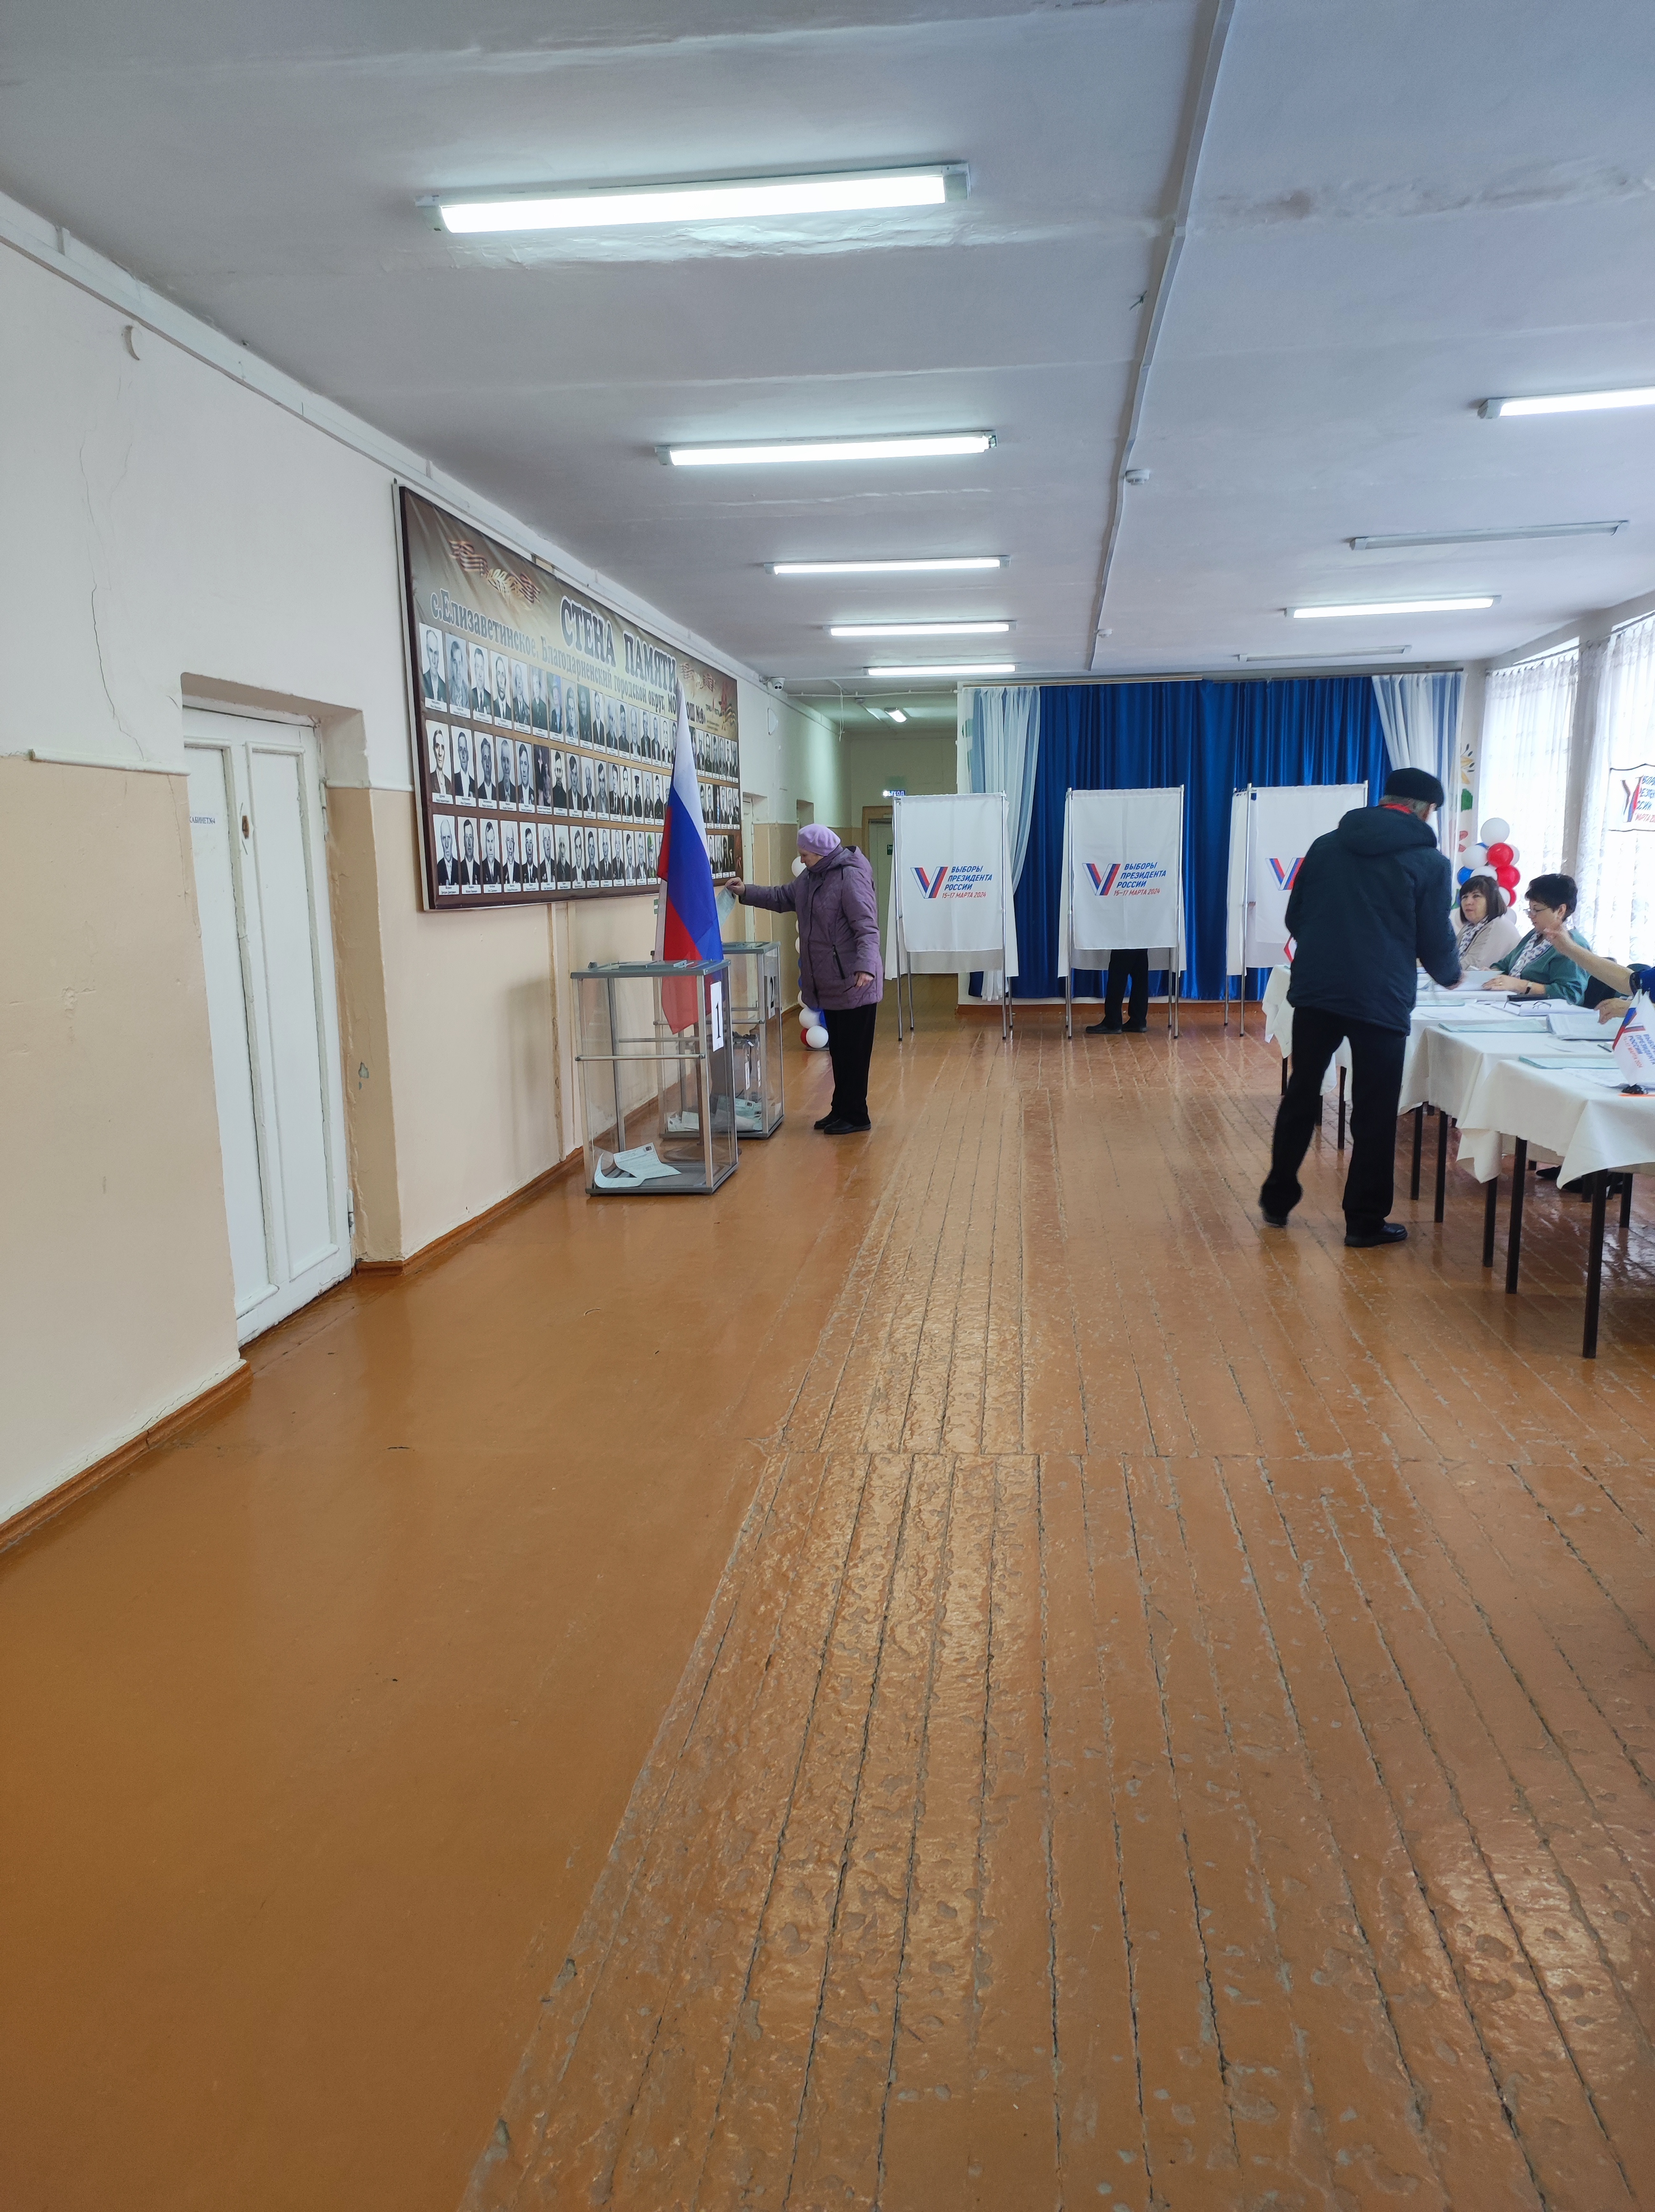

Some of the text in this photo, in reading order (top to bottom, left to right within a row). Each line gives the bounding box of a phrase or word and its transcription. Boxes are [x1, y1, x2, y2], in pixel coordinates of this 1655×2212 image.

[561, 596, 676, 695] СТЕНА ПАМЯТИ
[541, 635, 612, 689] Благодарненский
[614, 675, 647, 704] городской
[668, 693, 676, 715] МО
[1120, 870, 1166, 879] ПРЕЗИДЕНТА
[1124, 862, 1158, 870] ВЫБОРЫ
[947, 874, 993, 882] ПРЕЗИДЕНТА
[715, 1001, 721, 1039] 1
